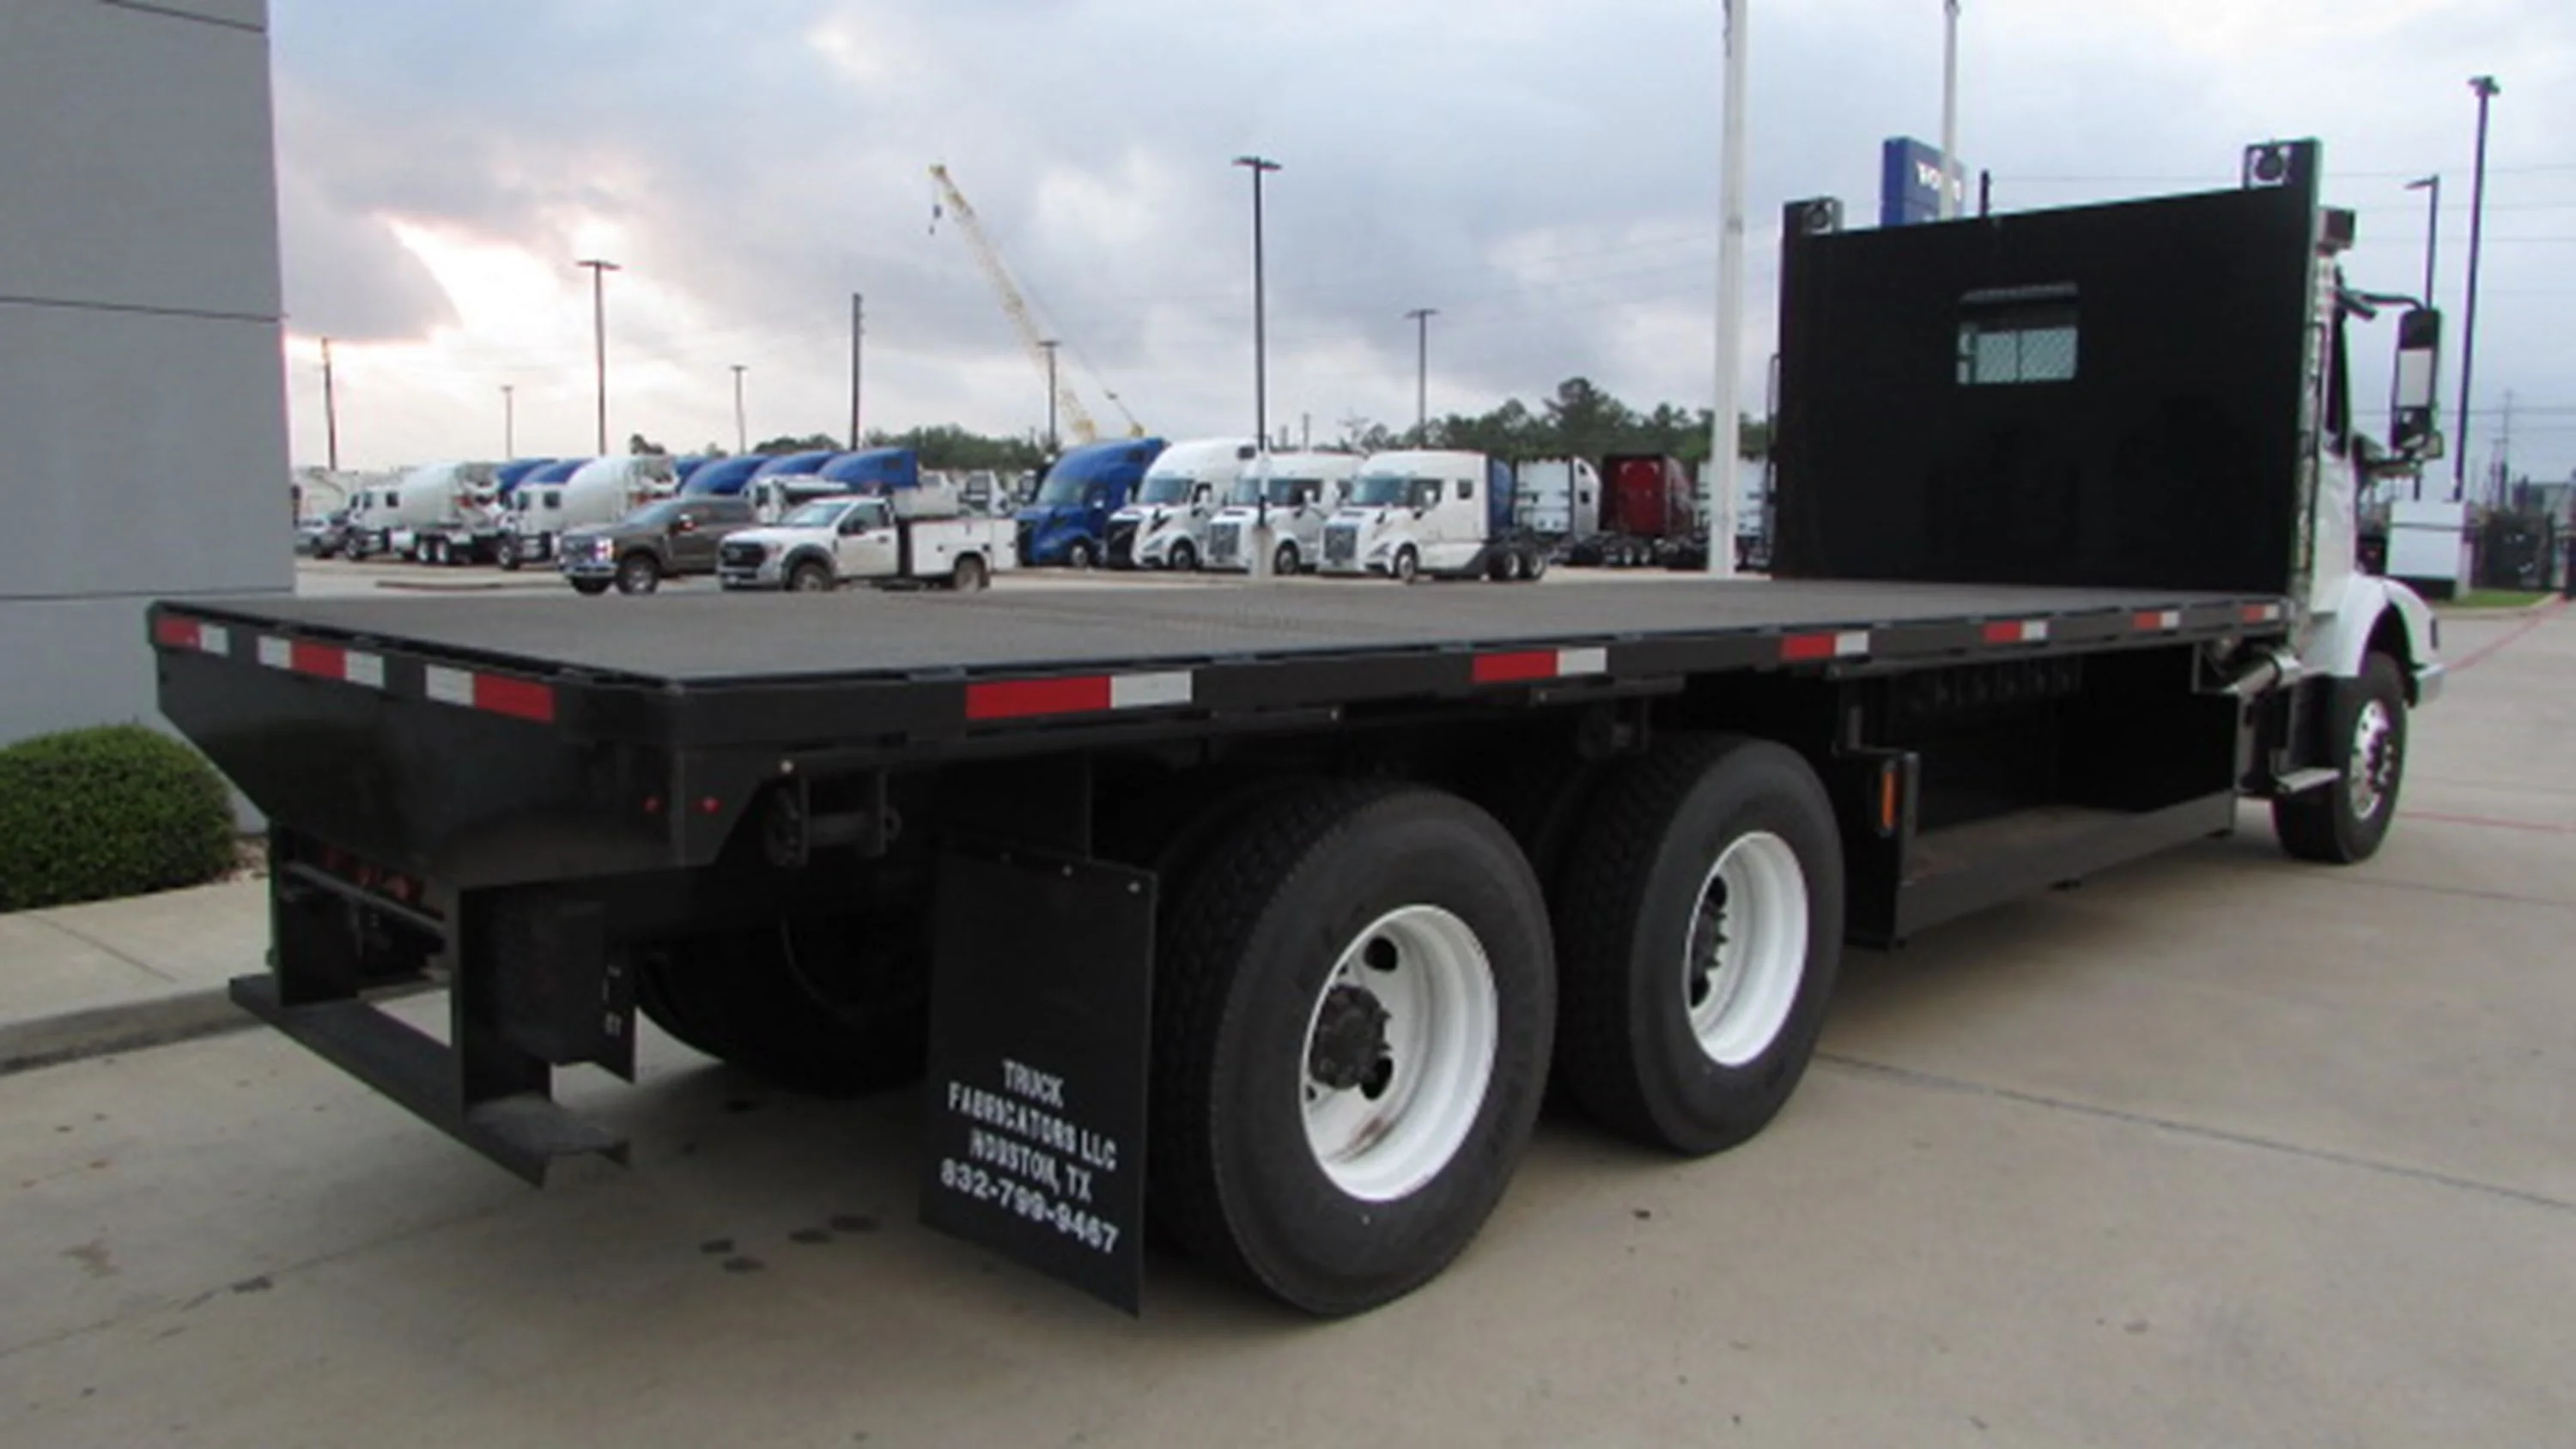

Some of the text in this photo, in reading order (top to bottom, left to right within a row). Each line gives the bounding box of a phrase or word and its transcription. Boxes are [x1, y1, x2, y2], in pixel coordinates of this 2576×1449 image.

[1002, 1058, 1065, 1108] TRUCK
[948, 1082, 1117, 1171] FABRICATORS LLC
[1066, 1162, 1092, 1202] TX
